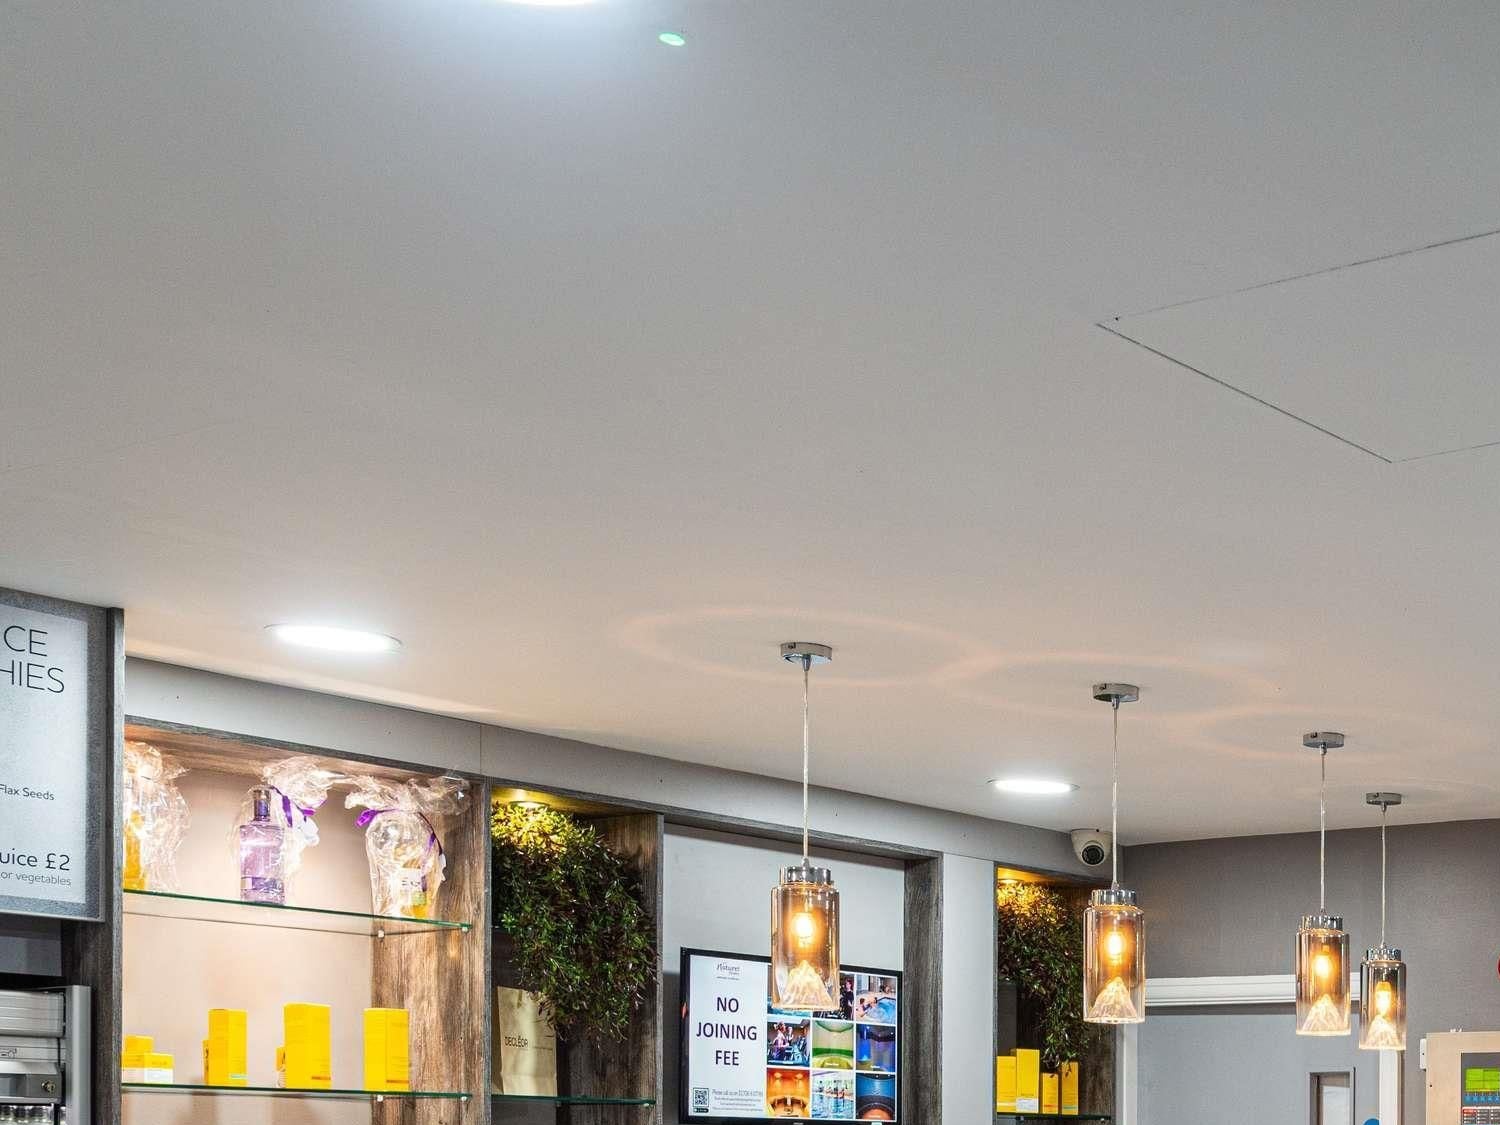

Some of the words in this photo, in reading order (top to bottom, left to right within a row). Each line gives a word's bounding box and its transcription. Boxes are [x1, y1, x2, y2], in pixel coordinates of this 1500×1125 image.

[22, 787, 55, 801] Seeds
[45, 852, 70, 871] £2
[1, 871, 13, 879] or
[16, 872, 71, 886] vegetables
[716, 997, 739, 1013] NO
[696, 1021, 758, 1041] JOINING
[715, 1050, 740, 1066] FEE
